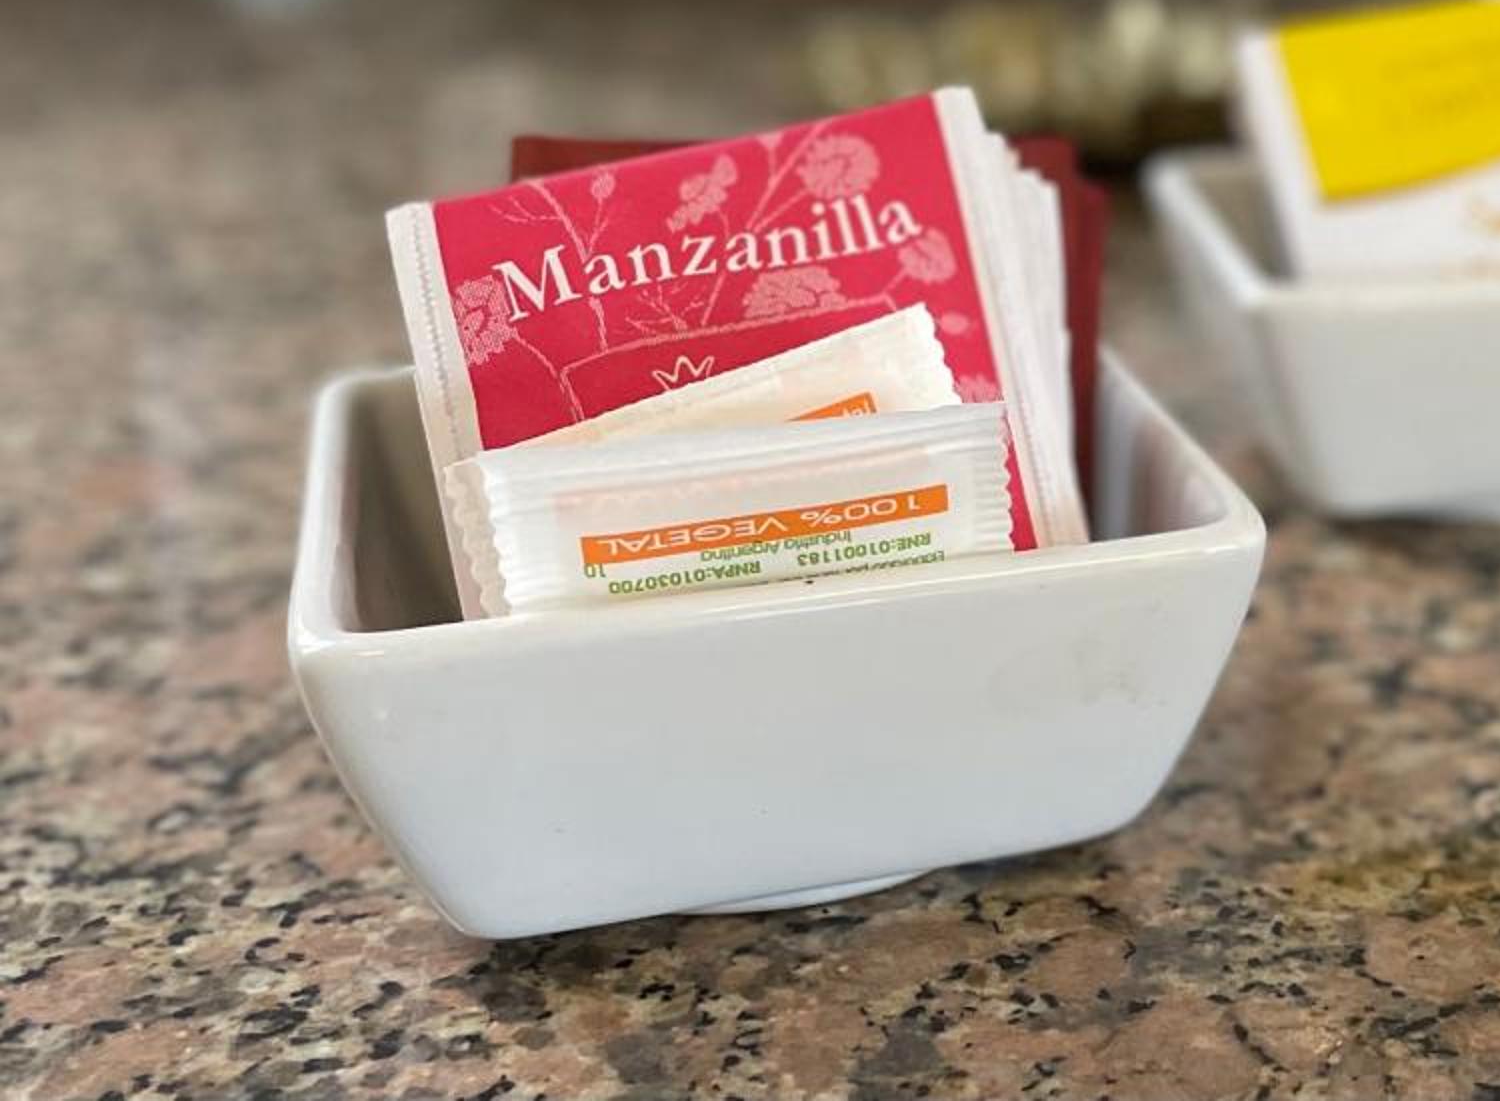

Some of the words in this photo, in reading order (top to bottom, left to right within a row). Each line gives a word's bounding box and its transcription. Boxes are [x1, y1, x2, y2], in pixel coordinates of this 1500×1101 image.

[493, 193, 925, 322] Manzanilla
[800, 494, 922, 527] 100%
[597, 515, 788, 556] VEGETAL
[700, 539, 779, 562] Argentina
[784, 530, 851, 550] Industria
[796, 531, 932, 567] RNE:01001183
[608, 560, 762, 595] RNPA:01030700
